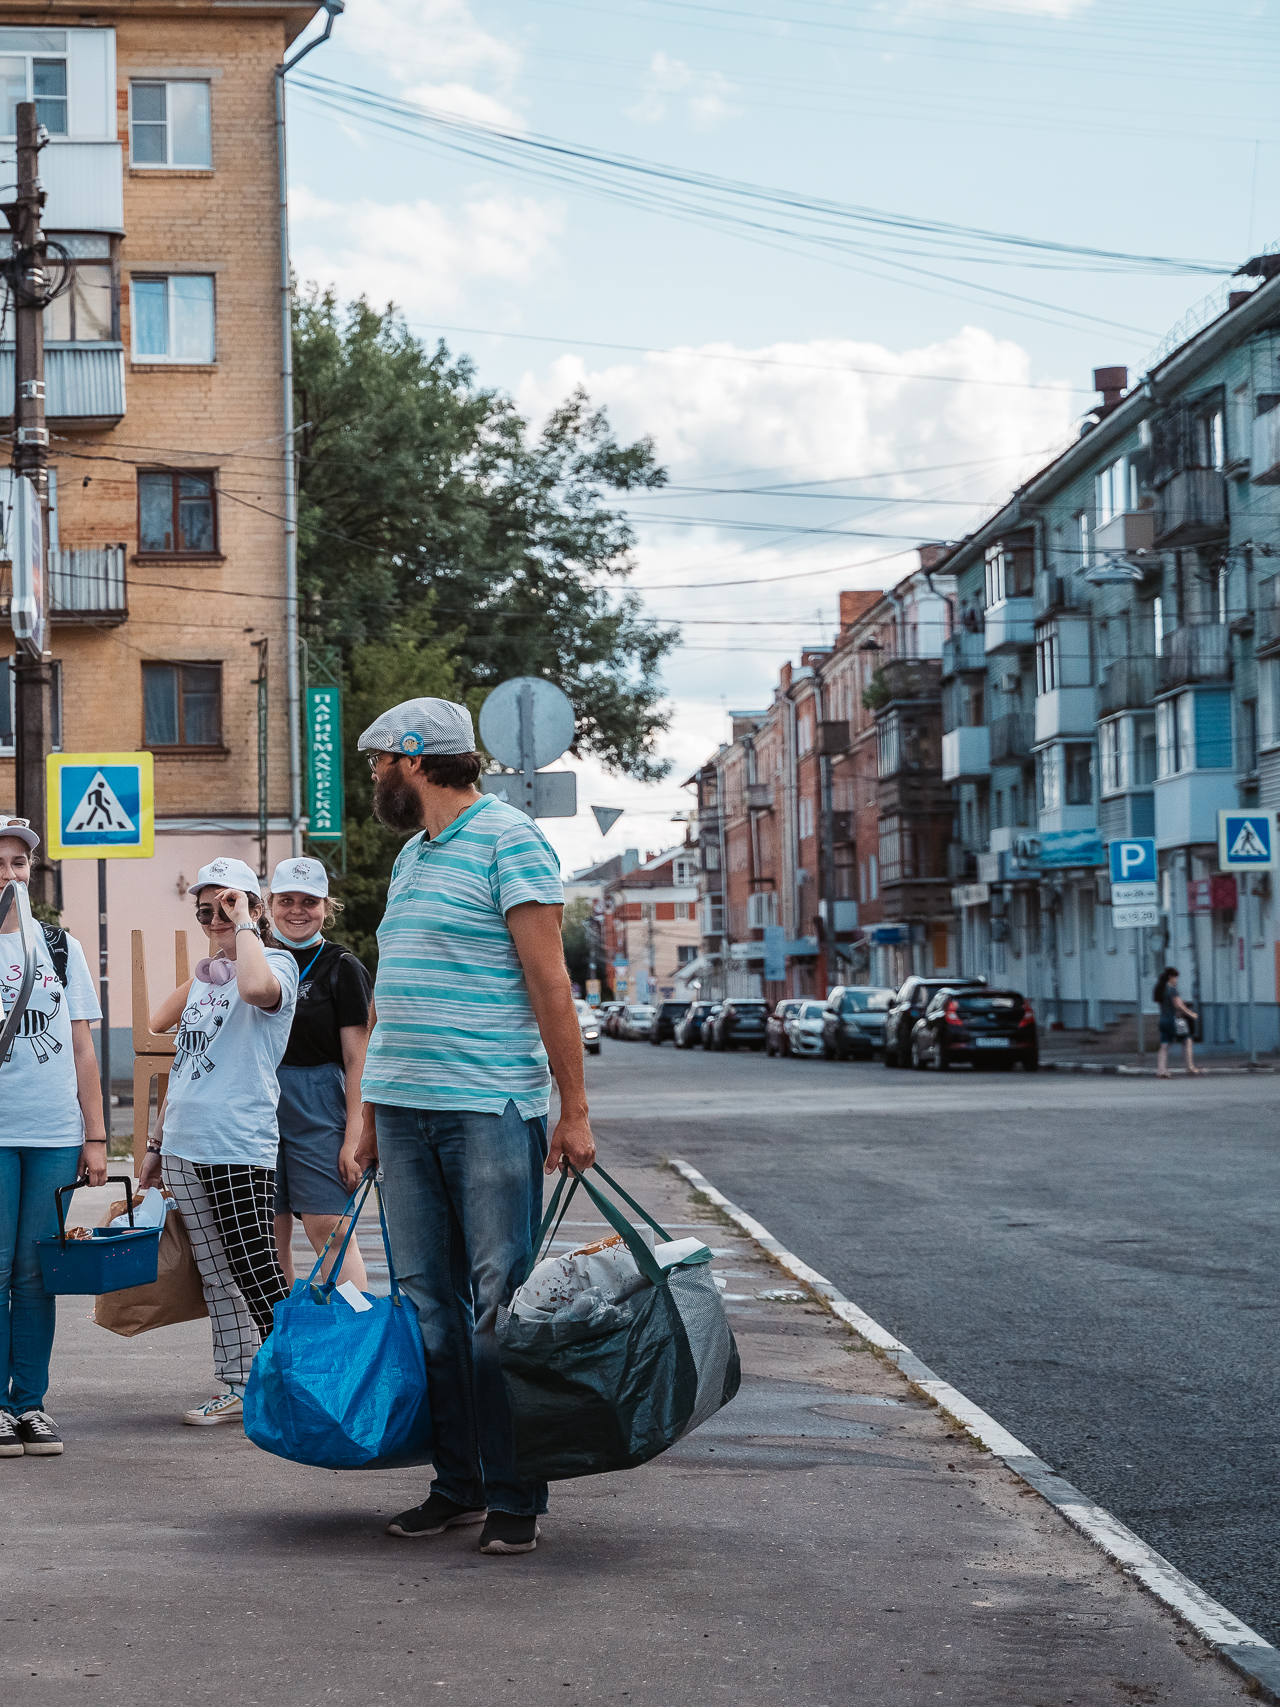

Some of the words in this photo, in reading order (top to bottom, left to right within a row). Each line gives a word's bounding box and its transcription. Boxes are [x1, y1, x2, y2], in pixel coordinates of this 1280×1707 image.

[313, 693, 333, 829] ПАРИКМАХЕРСКАЯ
[1120, 843, 1146, 878] P
[6, 964, 61, 988] Збра
